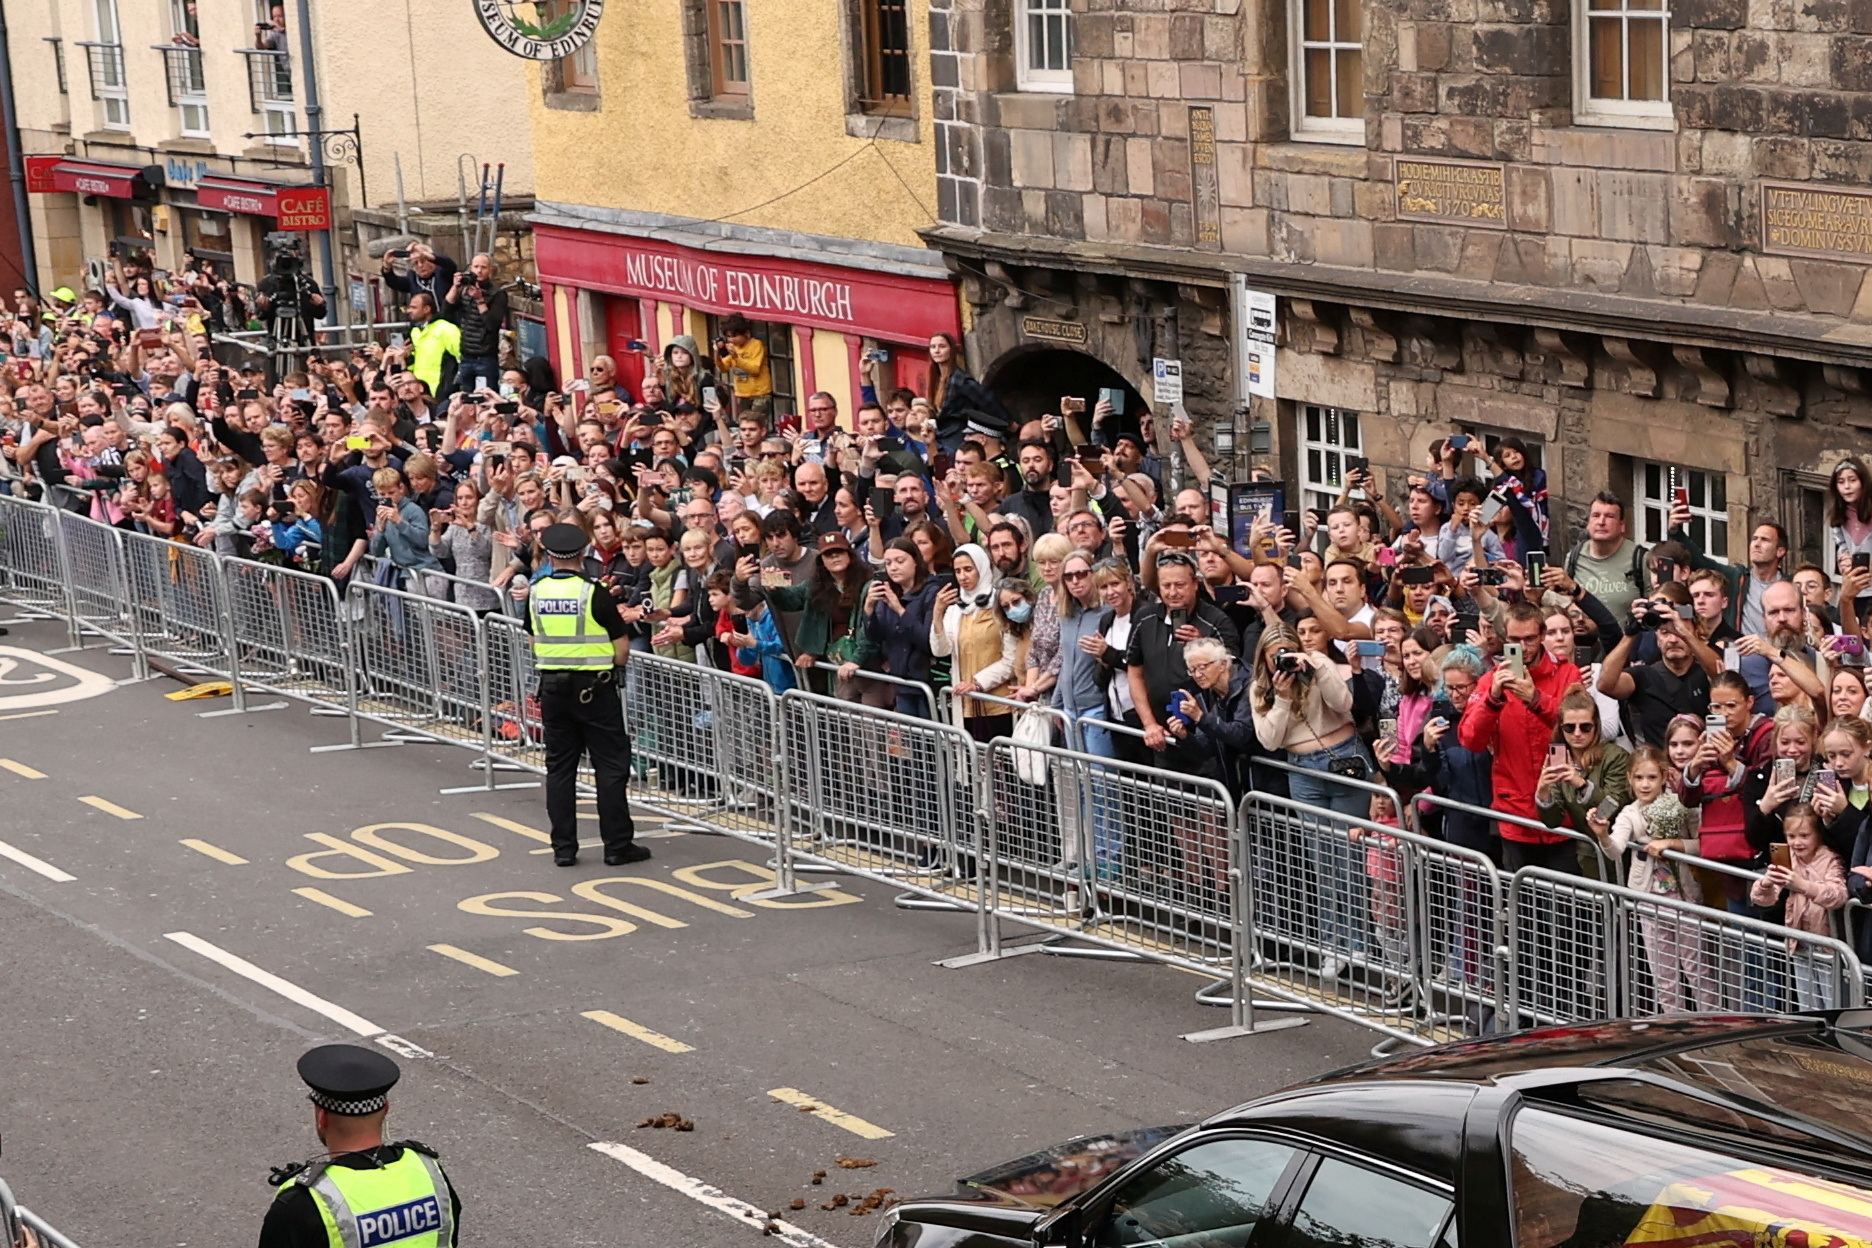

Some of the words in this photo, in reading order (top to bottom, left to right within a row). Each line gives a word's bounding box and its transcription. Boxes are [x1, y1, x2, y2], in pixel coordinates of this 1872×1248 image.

[480, 0, 518, 48] SEUM
[523, 41, 543, 58] OF
[227, 195, 240, 208] CAFE
[281, 196, 323, 215] CAFÉ
[1438, 199, 1470, 216] 1570
[282, 214, 325, 226] BISTRO
[1767, 209, 1784, 226] SIC
[1785, 211, 1807, 228] EGO
[1781, 228, 1844, 251] DOMINVS
[626, 252, 696, 297] MUSEUM
[697, 264, 718, 302] OF
[726, 270, 854, 321] EDINBURGH
[1585, 576, 1629, 594] Oliver
[538, 600, 578, 613] POLICE
[456, 860, 864, 941] BUS
[360, 1200, 438, 1244] POLICE
